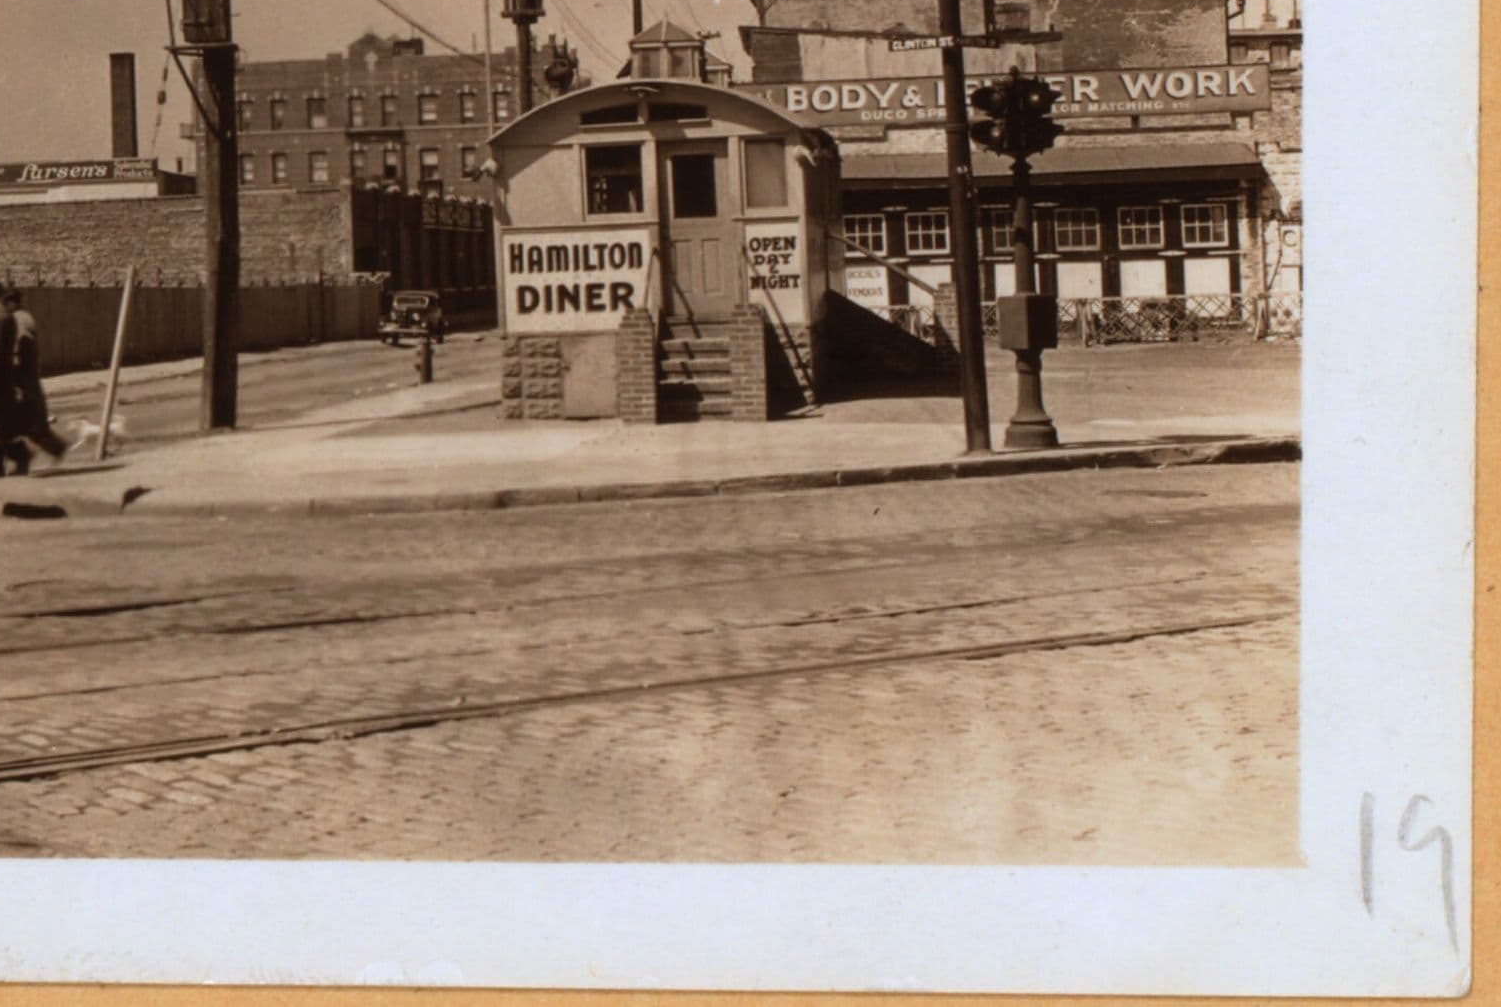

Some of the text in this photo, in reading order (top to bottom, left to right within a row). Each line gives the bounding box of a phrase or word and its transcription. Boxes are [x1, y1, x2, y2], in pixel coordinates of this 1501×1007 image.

[891, 39, 937, 51] CLINTON
[787, 83, 899, 113] BODY
[902, 85, 924, 108] &
[1120, 67, 1256, 99] WORK
[861, 109, 908, 121] DUCO
[1088, 99, 1164, 112] MATCHING
[748, 236, 797, 252] OPEN
[509, 243, 644, 274] HAMILTON
[753, 254, 792, 265] DAY
[749, 274, 800, 290] NIGHT
[516, 282, 636, 315] DINER
[1359, 791, 1460, 955] 19
